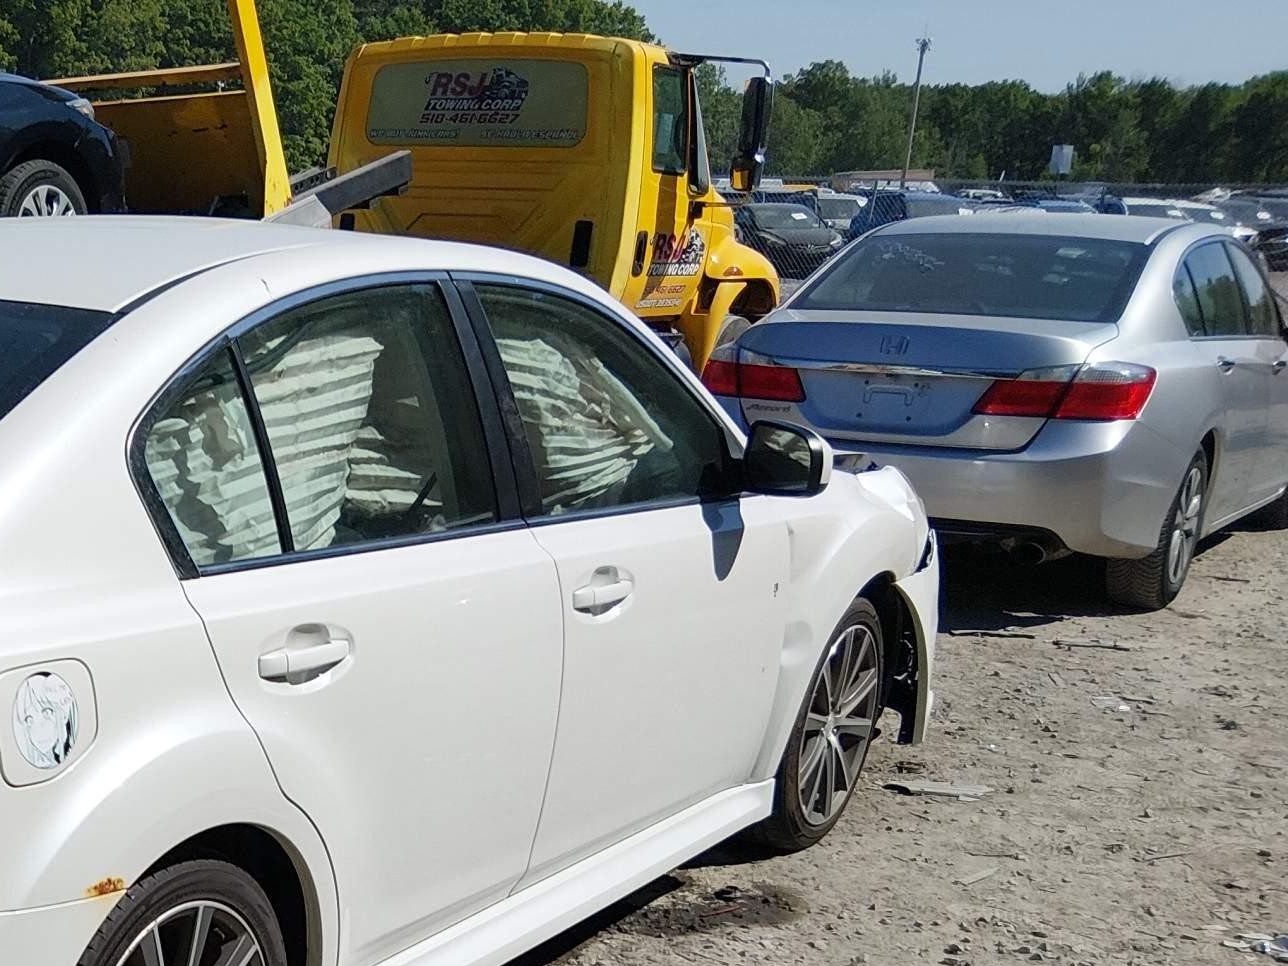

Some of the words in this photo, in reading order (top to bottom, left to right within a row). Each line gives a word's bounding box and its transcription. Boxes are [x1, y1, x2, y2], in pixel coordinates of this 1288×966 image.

[430, 71, 487, 97] RSJ
[428, 99, 481, 110] TOWING
[481, 99, 522, 110] CORP
[678, 263, 700, 275] CORP
[745, 403, 791, 413] Accord
